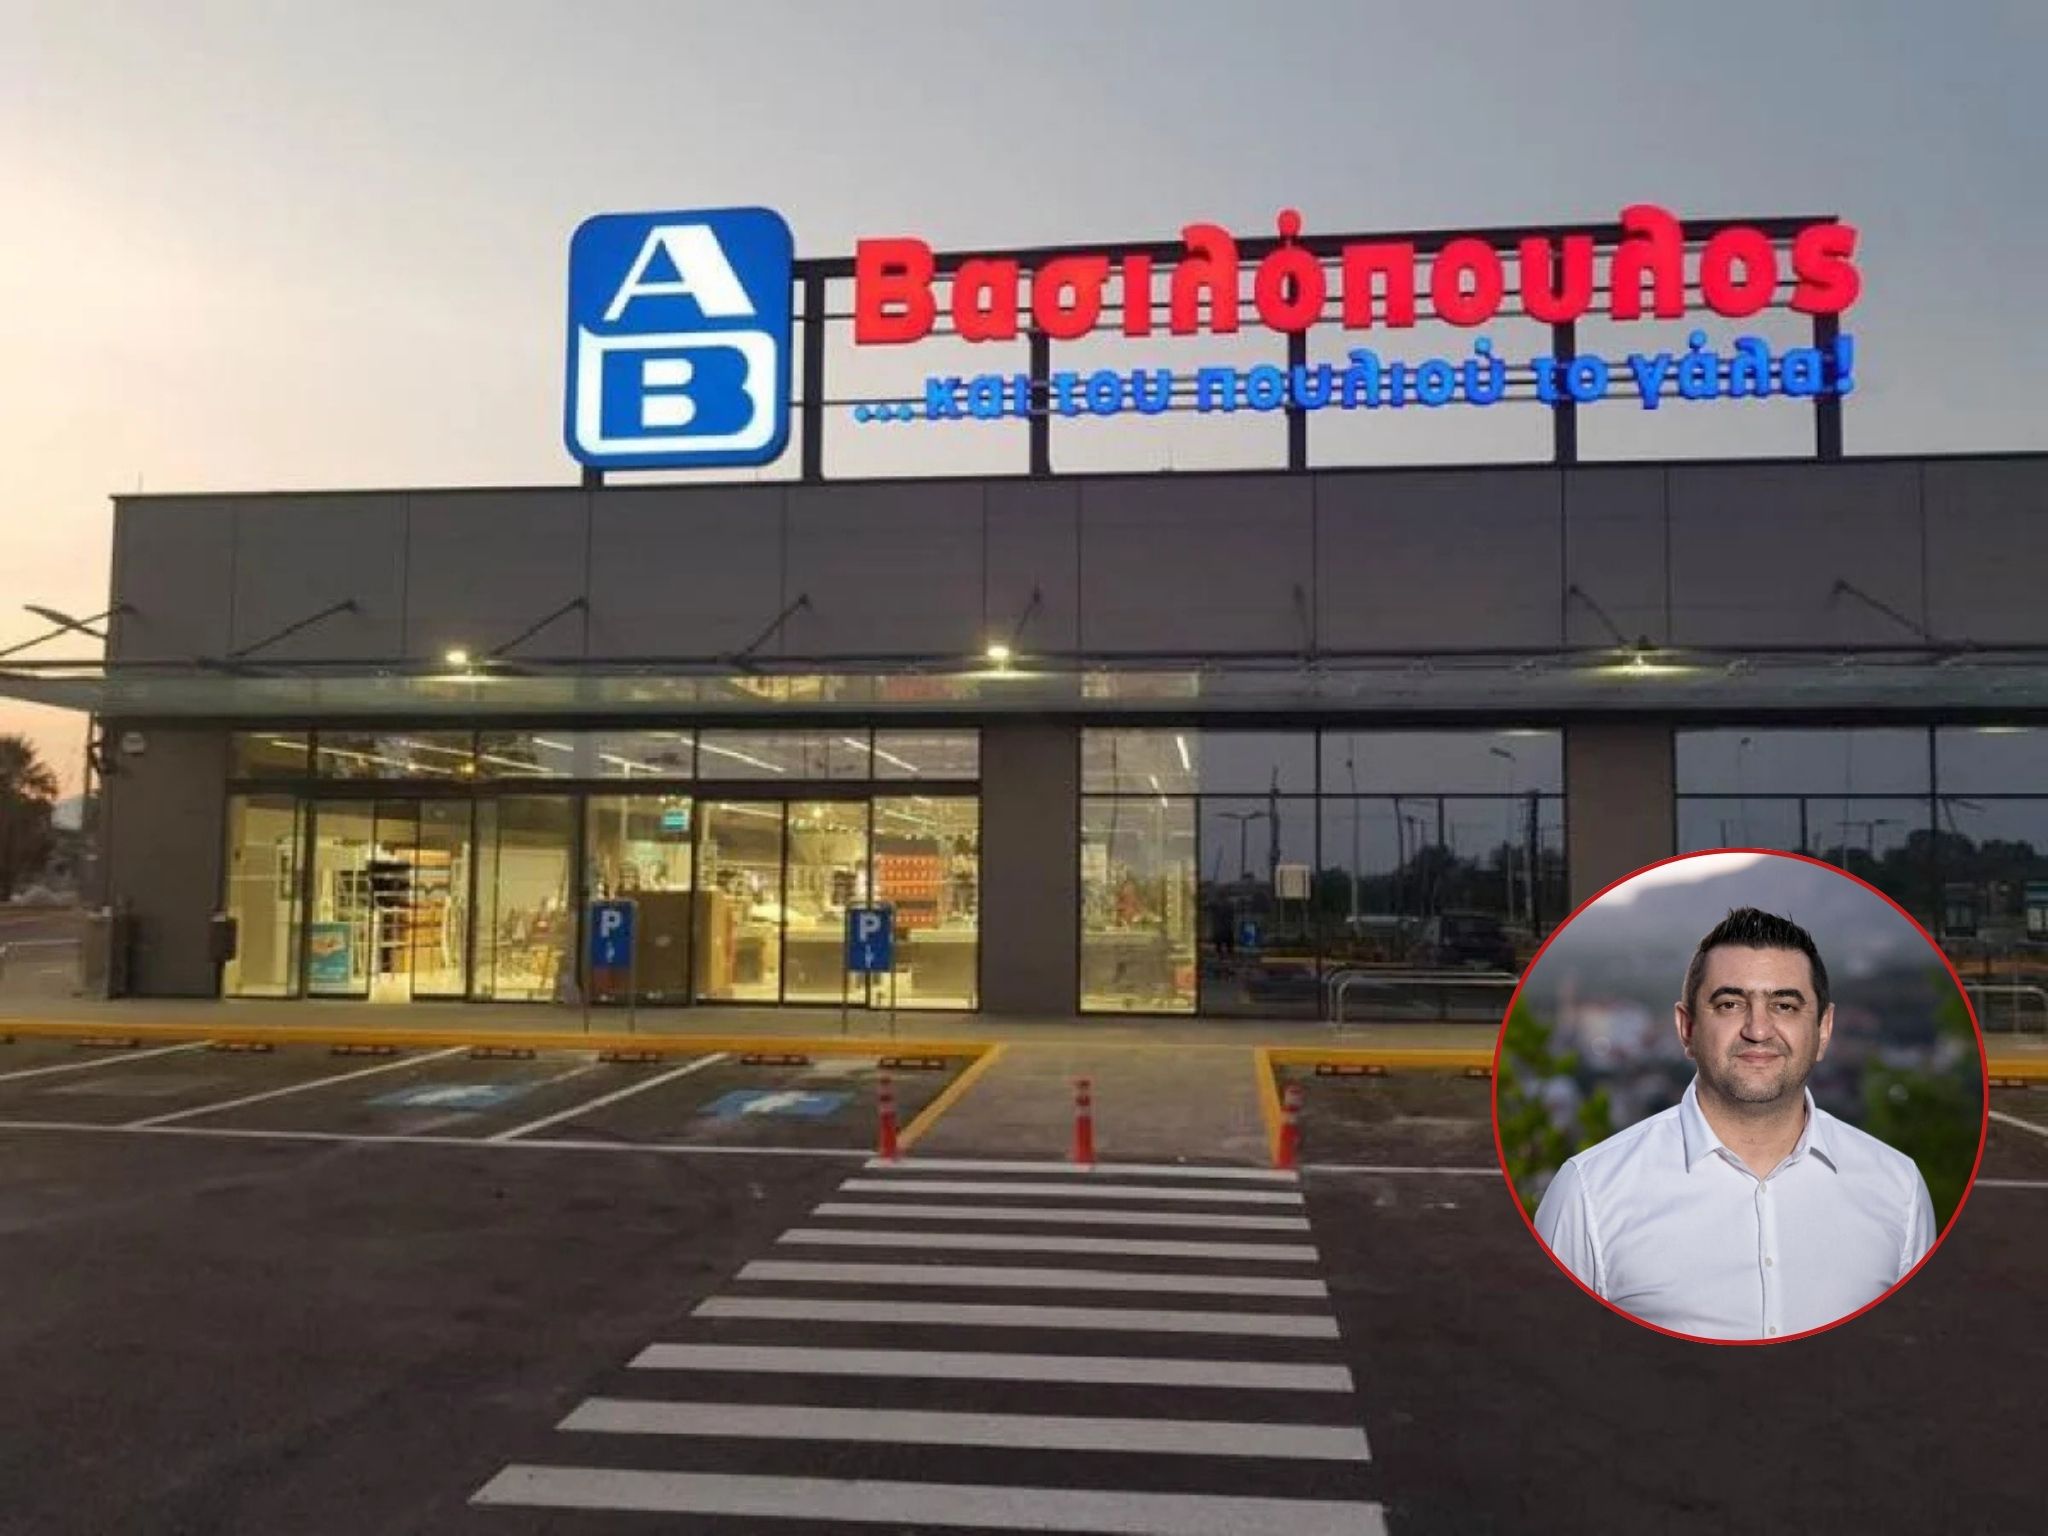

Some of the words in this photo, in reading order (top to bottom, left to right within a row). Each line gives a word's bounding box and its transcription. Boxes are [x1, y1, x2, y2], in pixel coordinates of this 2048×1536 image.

[853, 204, 1861, 345] Βασιλόπουλος
[1051, 368, 1176, 417] του
[1194, 336, 1510, 414] πουλιού
[1528, 352, 1613, 409] το
[1625, 327, 1856, 411] γάλα!
[601, 910, 621, 938] P
[859, 913, 881, 942] P
